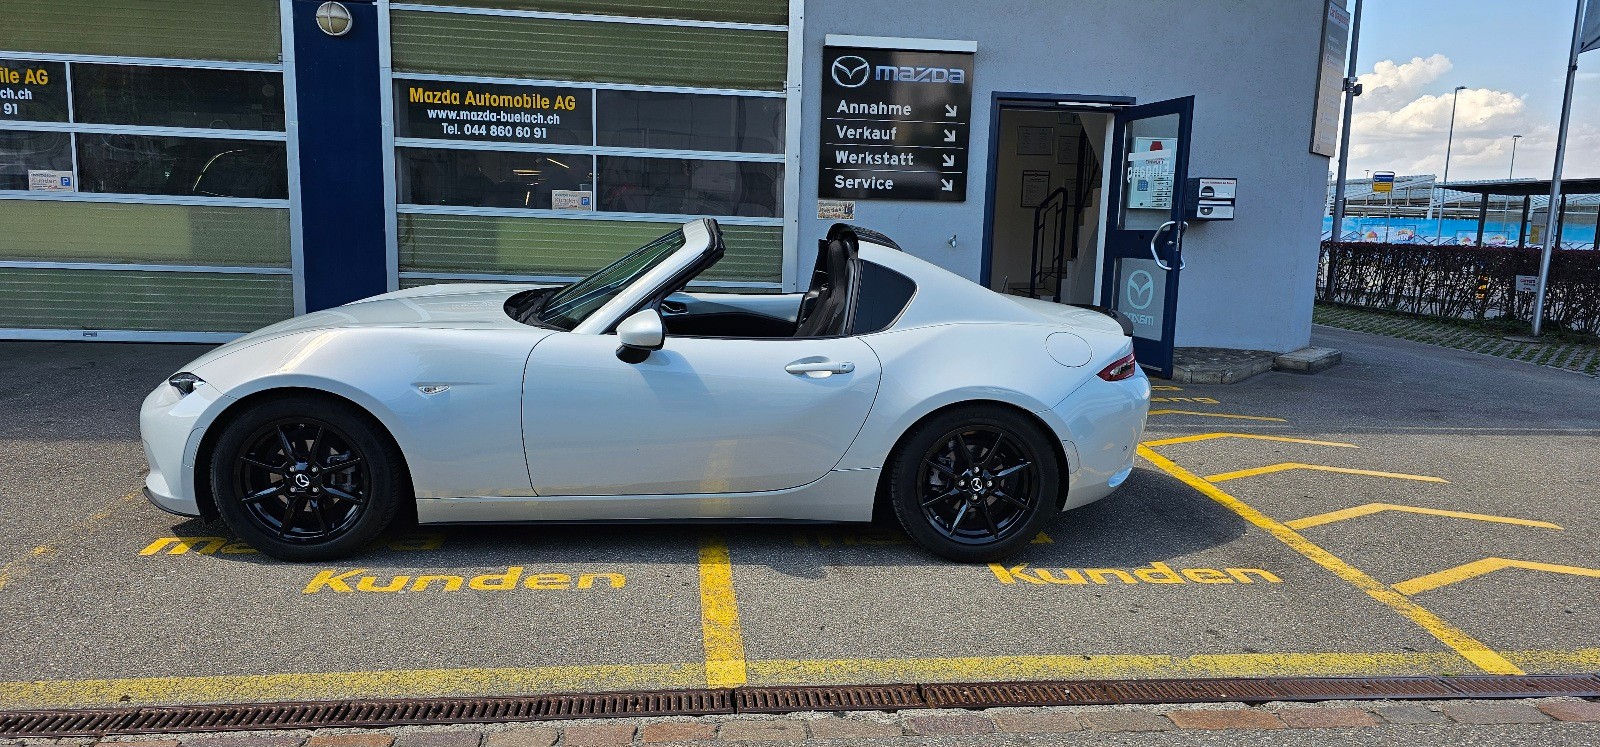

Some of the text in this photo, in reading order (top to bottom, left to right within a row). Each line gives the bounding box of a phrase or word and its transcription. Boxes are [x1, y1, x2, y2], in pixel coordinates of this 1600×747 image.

[0, 66, 49, 85] ile AG
[875, 65, 965, 84] mazda
[0, 87, 33, 100] ch.ch
[409, 87, 576, 111] Mazda Automobile AG
[3, 102, 18, 115] 91
[836, 100, 912, 116] Annahme
[427, 109, 560, 125] www.mazda-buelach.ch
[442, 122, 548, 139] Tel. 044 860 60 91
[836, 124, 897, 140] Verkauf
[835, 150, 914, 166] Werkstatt
[834, 175, 894, 190] Service
[302, 566, 627, 594] Kunden
[987, 562, 1284, 585] Kunden
